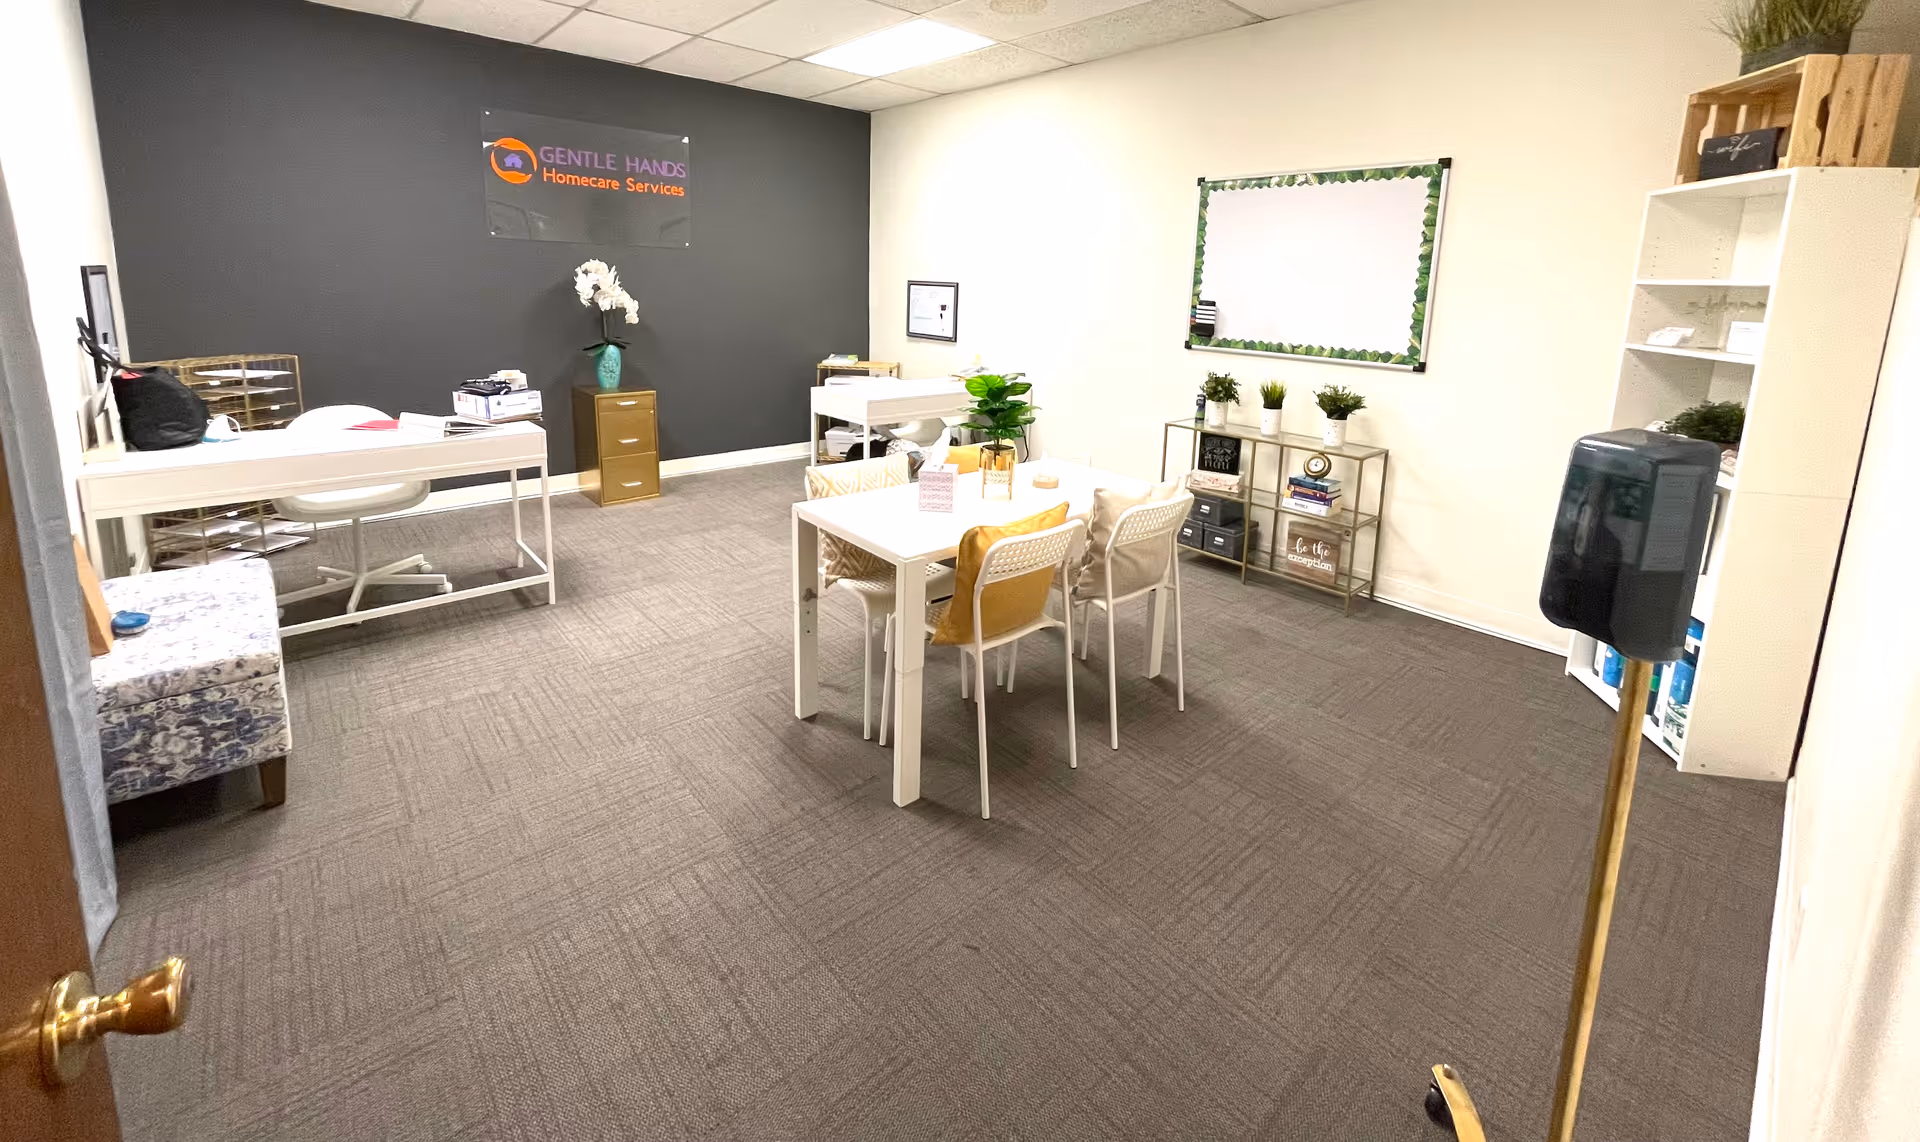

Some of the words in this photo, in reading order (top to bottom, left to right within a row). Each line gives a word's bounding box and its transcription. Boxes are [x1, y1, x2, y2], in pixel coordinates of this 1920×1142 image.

[539, 146, 617, 171] GENTLE
[625, 156, 687, 179] HANDS
[543, 167, 620, 191] Homecare
[626, 178, 685, 197] Services
[1291, 537, 1308, 554] be
[1313, 541, 1331, 560] the
[1287, 553, 1333, 572] exception
